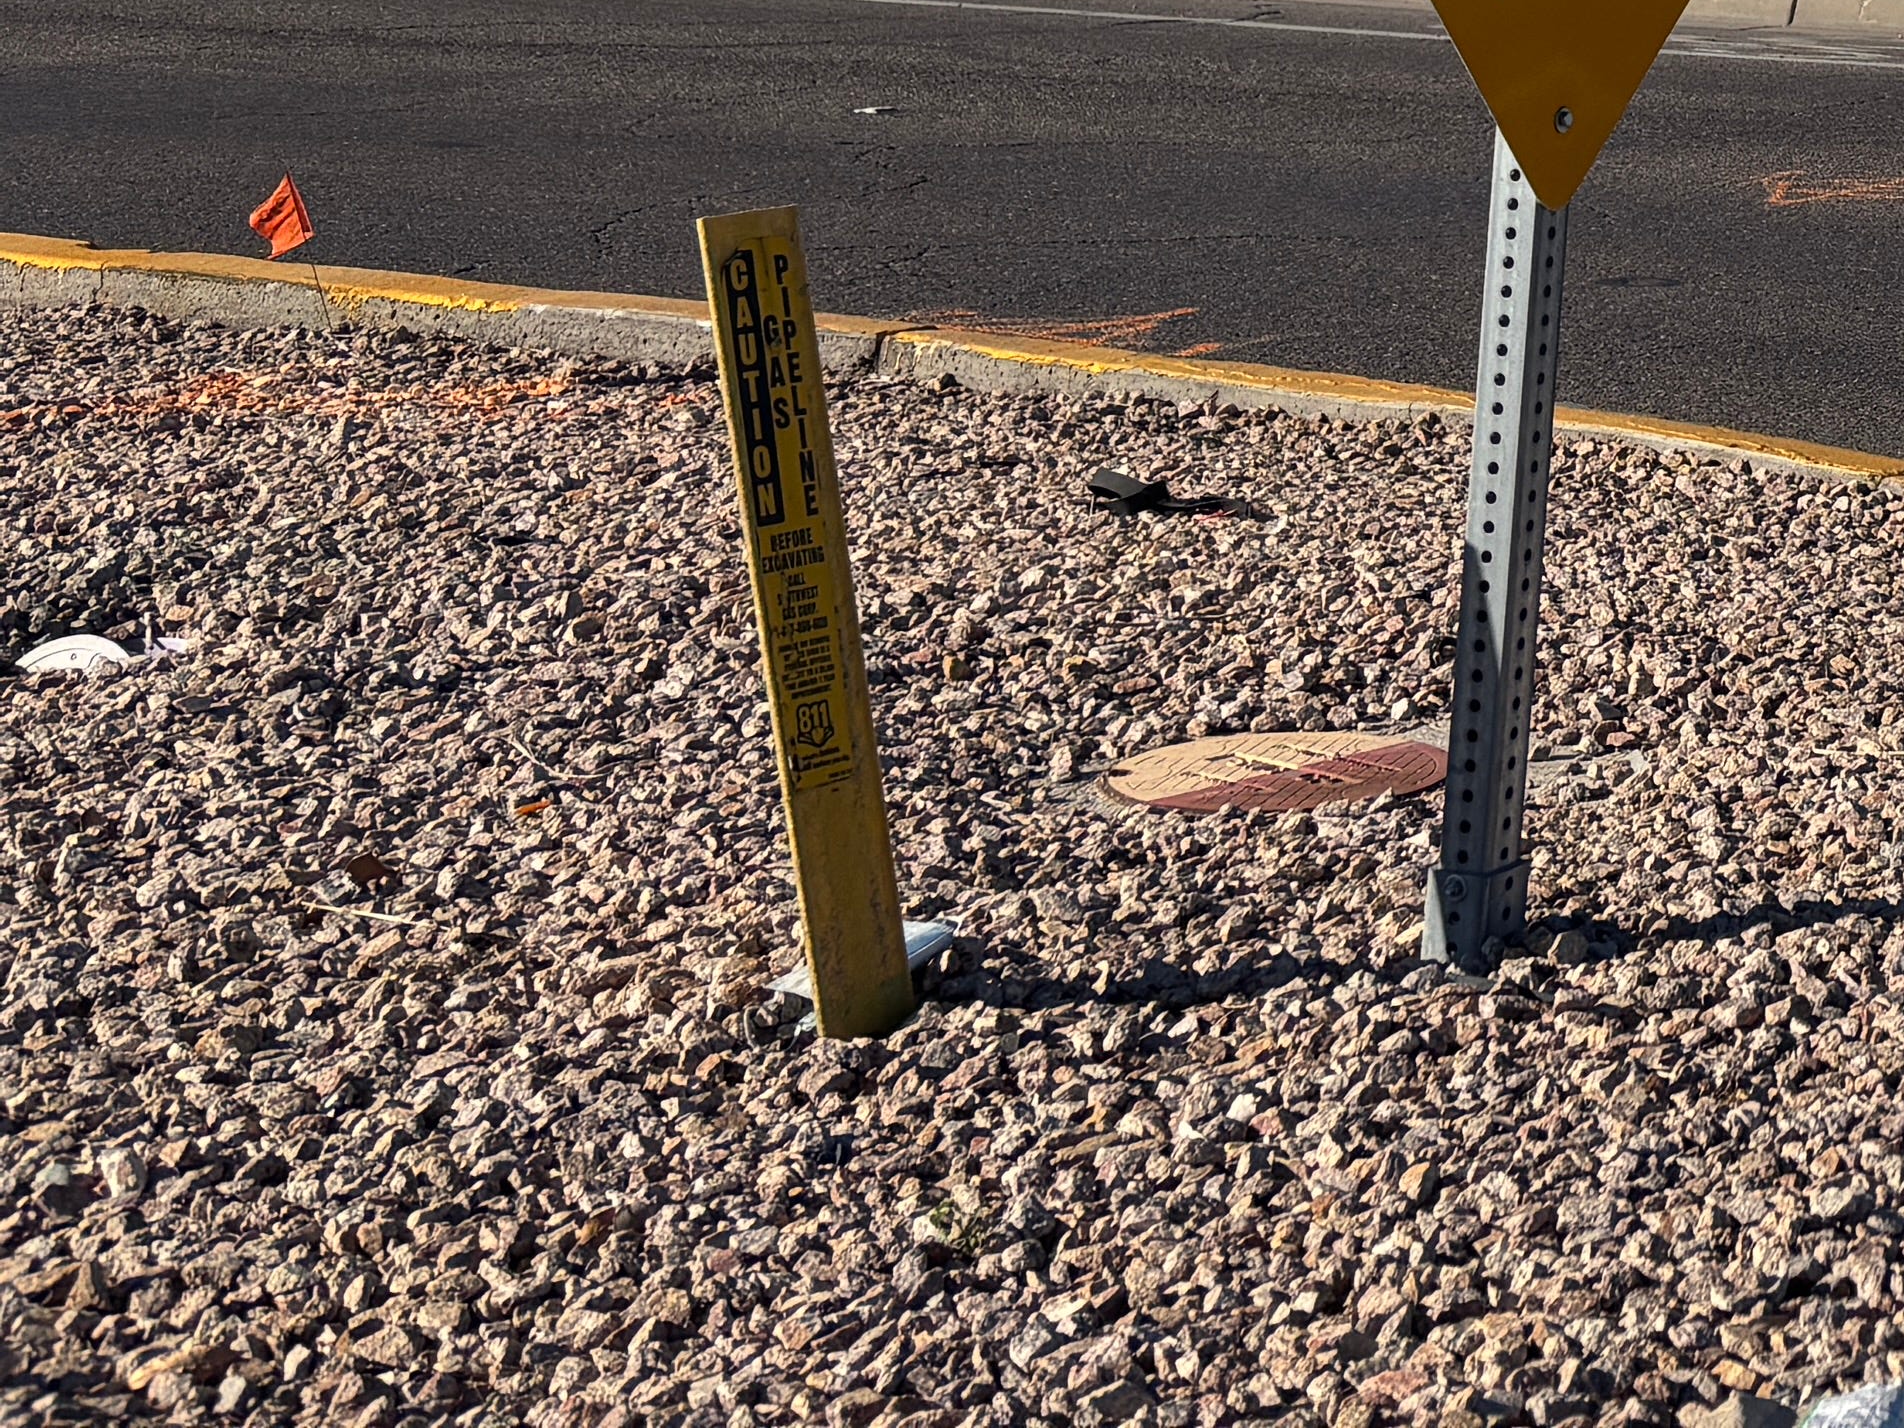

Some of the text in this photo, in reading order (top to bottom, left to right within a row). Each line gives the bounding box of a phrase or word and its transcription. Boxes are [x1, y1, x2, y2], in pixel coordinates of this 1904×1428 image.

[729, 258, 777, 517] CAUTION
[763, 314, 790, 429] GAS
[773, 254, 819, 517] PIPELINE
[762, 545, 825, 574] EXCAVATING
[770, 527, 813, 552] BEFORE
[797, 698, 831, 733] 811
